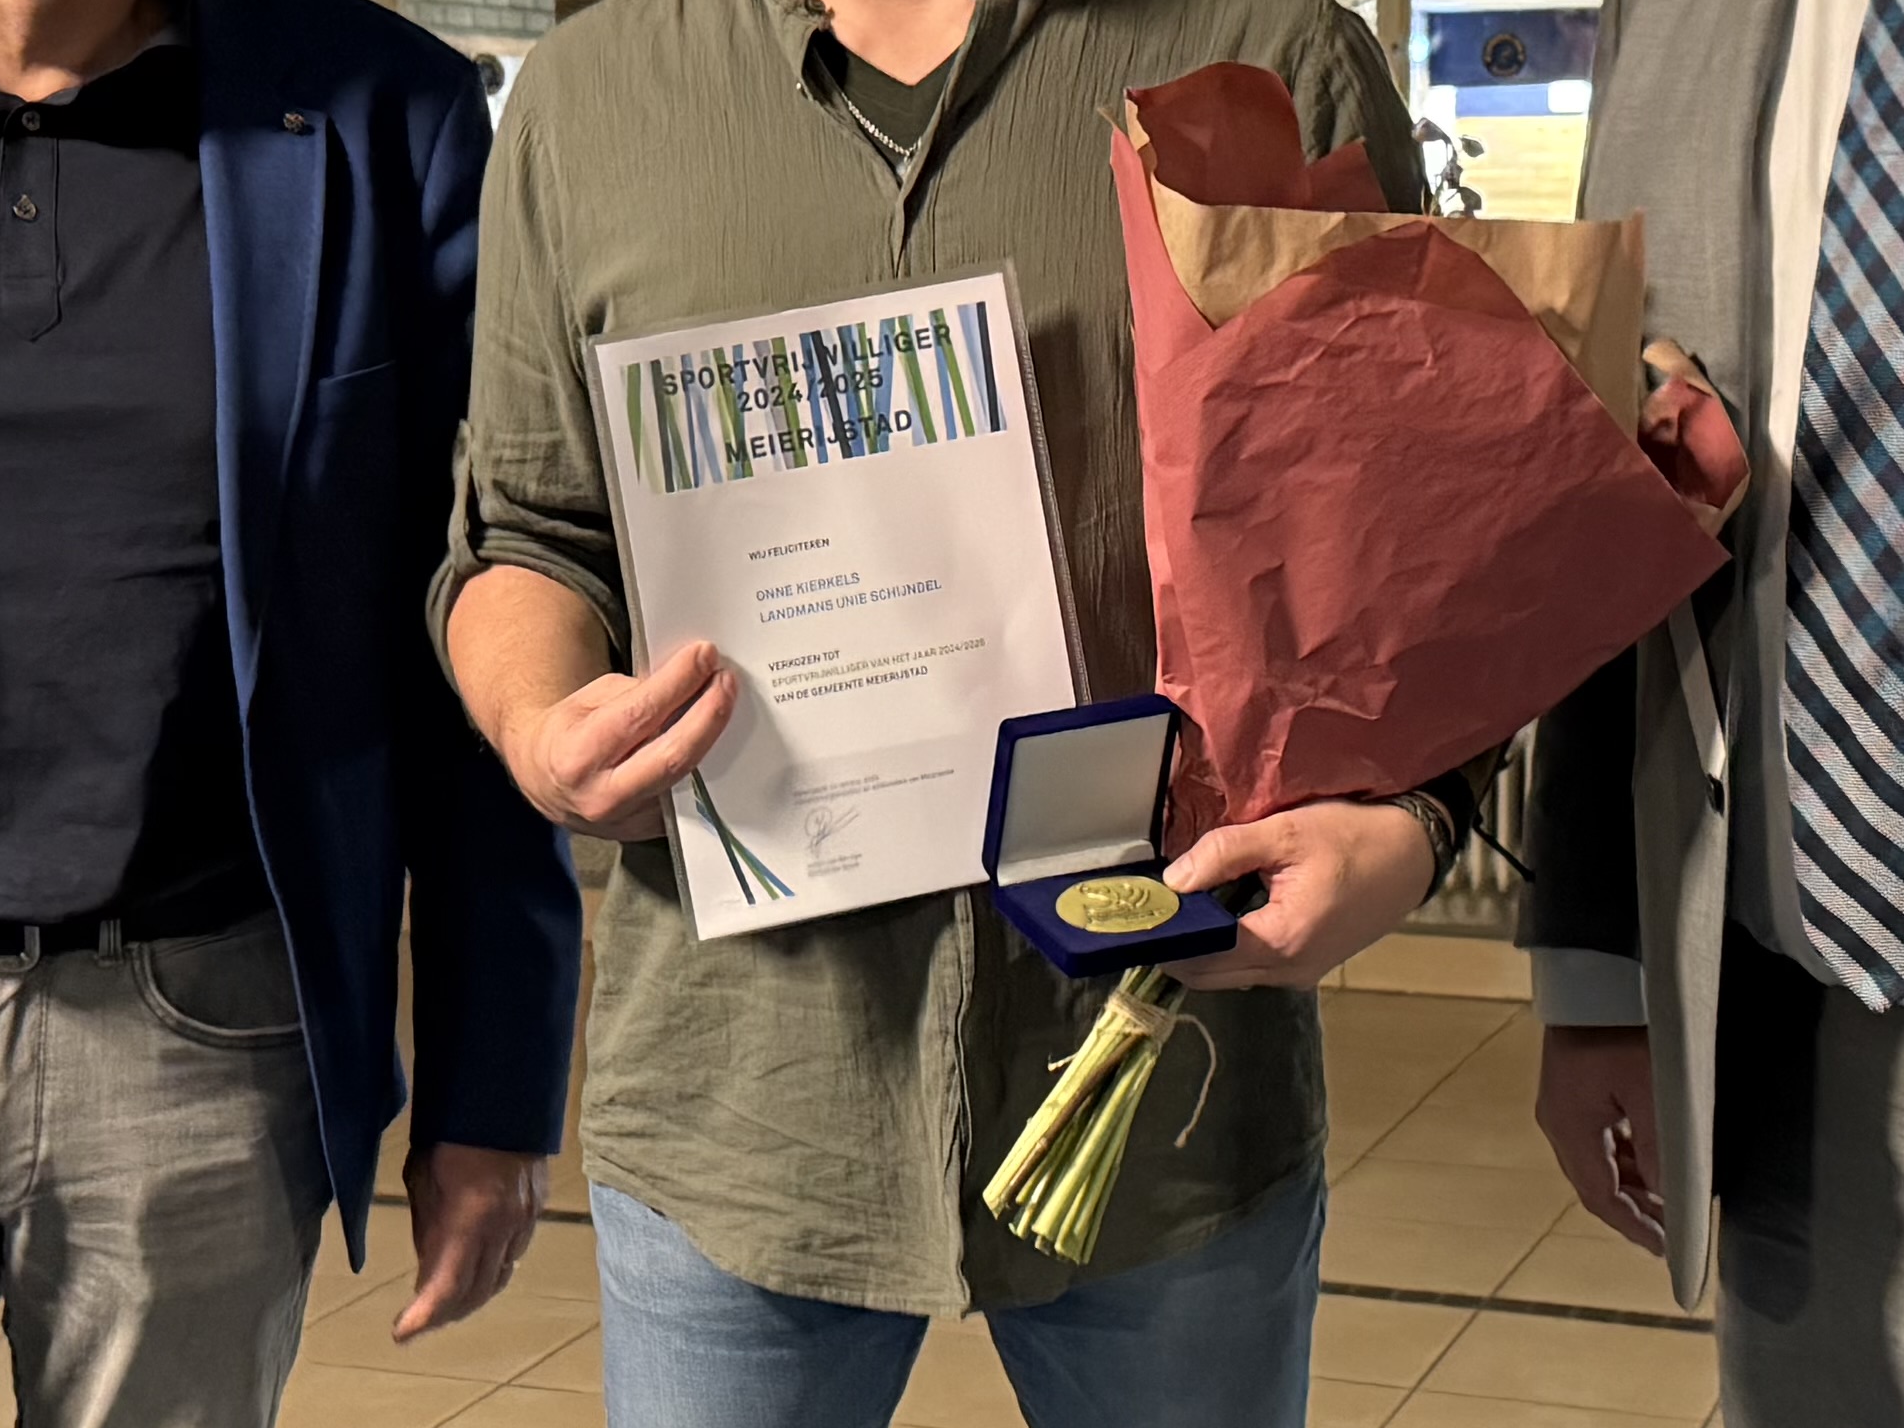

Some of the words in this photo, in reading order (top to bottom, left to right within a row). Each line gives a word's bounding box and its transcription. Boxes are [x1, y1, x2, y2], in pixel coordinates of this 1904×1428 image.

[737, 368, 884, 412] 2024/2025
[725, 409, 913, 463] MEIERIJSTAD
[748, 550, 766, 561] WIJ
[756, 584, 794, 602] ONNE
[796, 572, 860, 595] KIERKELS
[759, 599, 834, 623] LANDMANS
[836, 592, 868, 609] UNIE
[871, 579, 942, 603] SCHIJNDEL
[822, 650, 840, 661] TOT
[774, 692, 794, 704] VAN
[796, 688, 810, 700] DE
